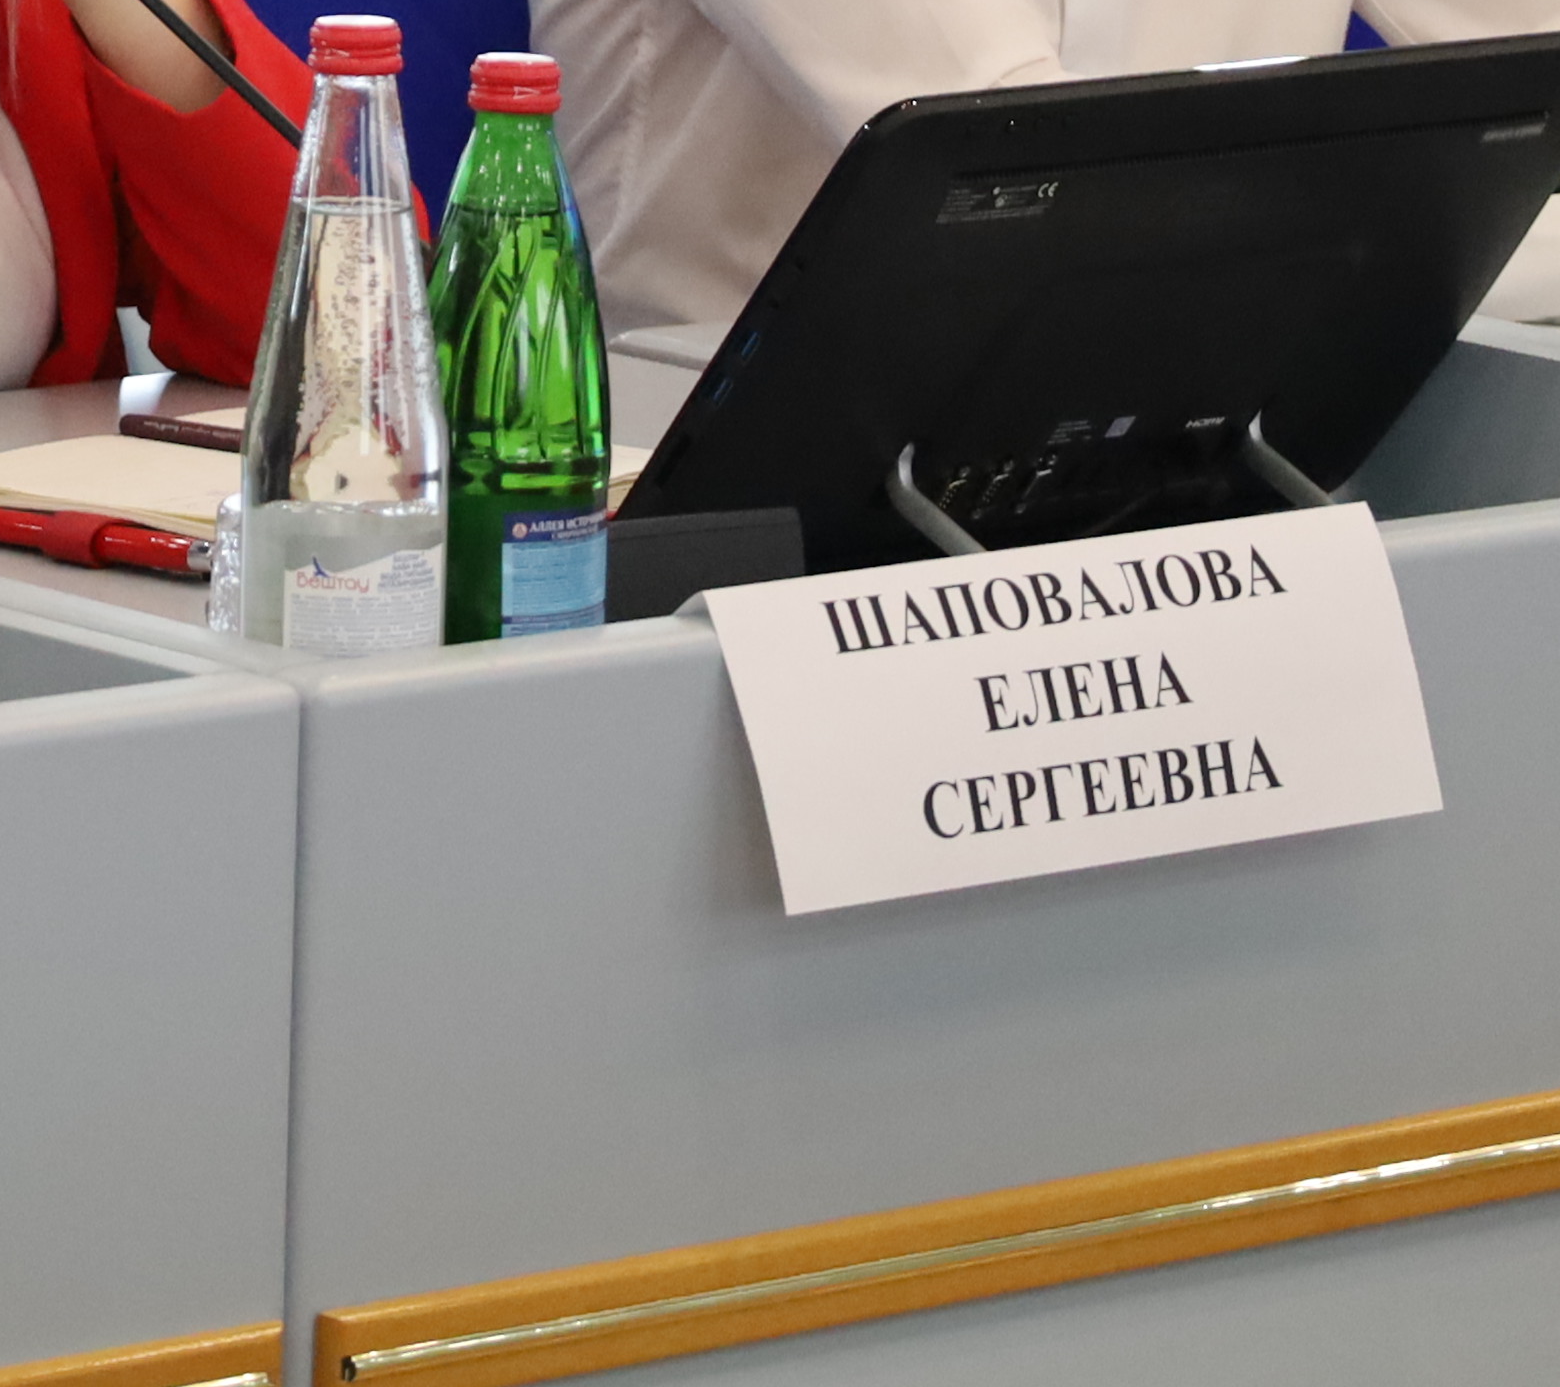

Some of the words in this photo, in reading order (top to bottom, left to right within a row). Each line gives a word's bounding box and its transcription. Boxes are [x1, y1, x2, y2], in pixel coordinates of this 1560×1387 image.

[820, 544, 1288, 656] ШАПОВАЛОВА
[976, 651, 1194, 735] ЕЛЕНА
[920, 735, 1284, 842] СЕРГЕЕВНА
